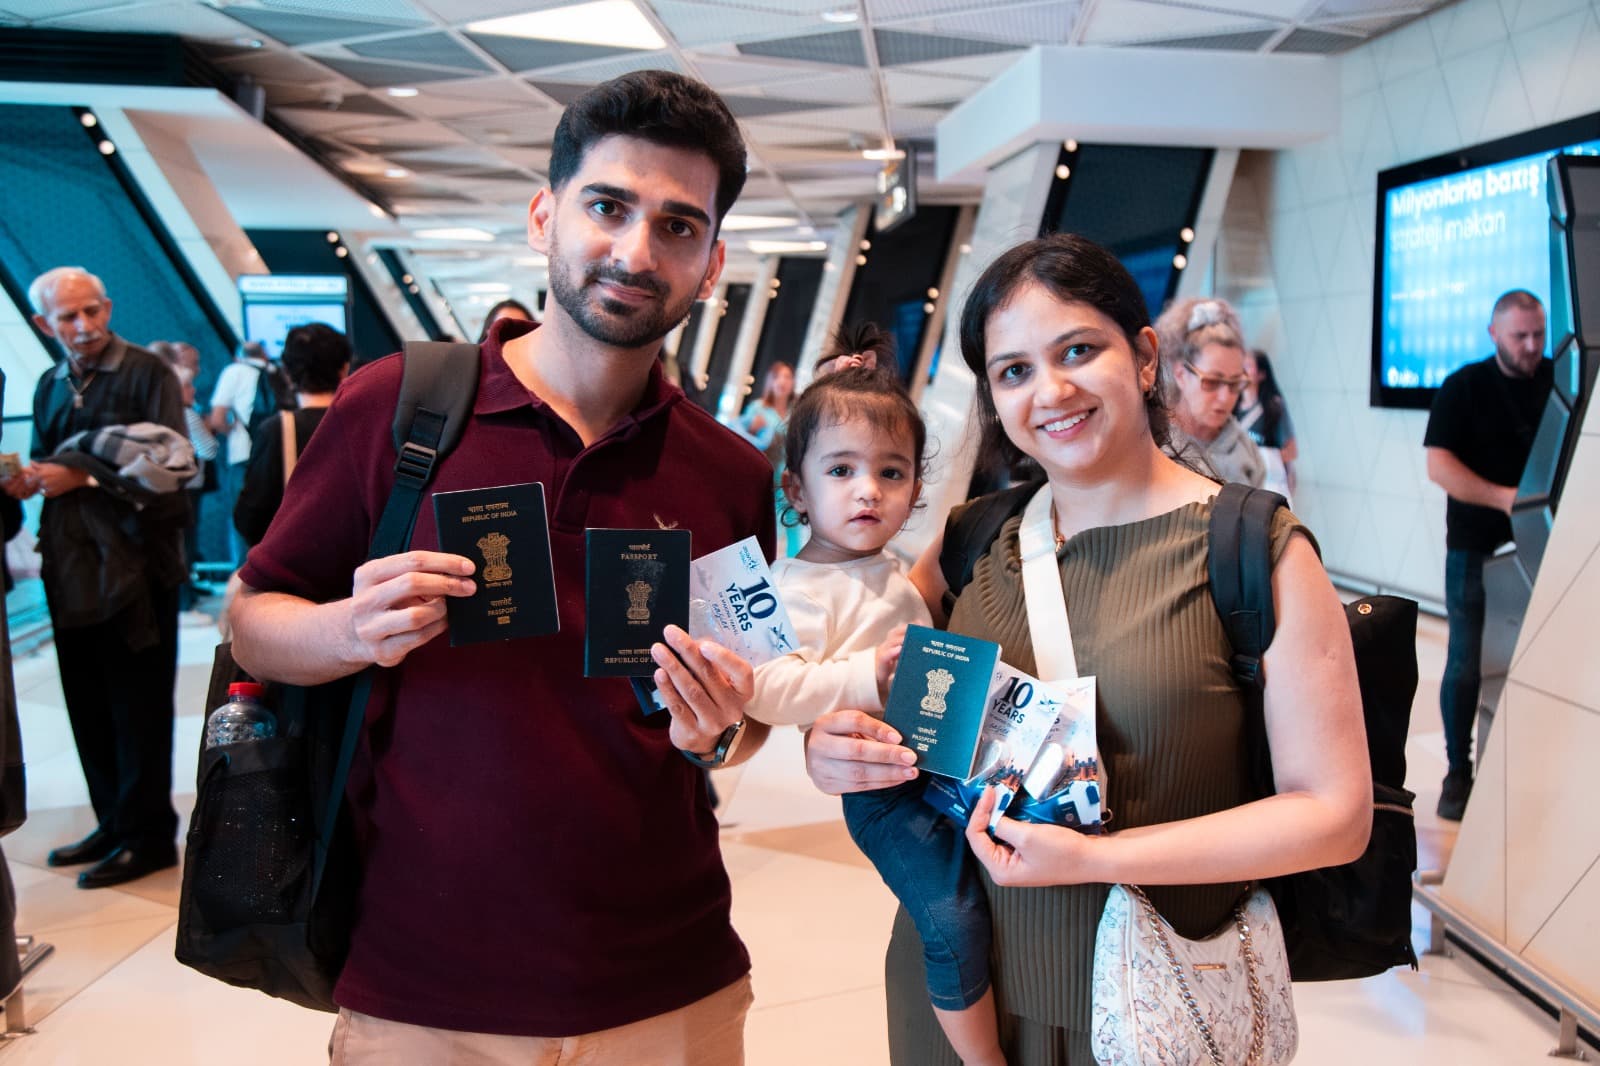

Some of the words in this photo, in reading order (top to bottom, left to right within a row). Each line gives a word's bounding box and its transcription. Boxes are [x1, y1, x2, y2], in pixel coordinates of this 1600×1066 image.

[462, 513, 490, 523] REPUBLIC
[500, 510, 518, 518] INDIA
[726, 582, 753, 632] YEARS
[738, 576, 777, 619] 10
[488, 606, 518, 616] PASSPORT
[922, 646, 946, 657] REPUBLIC
[1000, 676, 1034, 709] 10
[992, 698, 1025, 724] YEARS
[911, 734, 938, 744] PASSPORT
